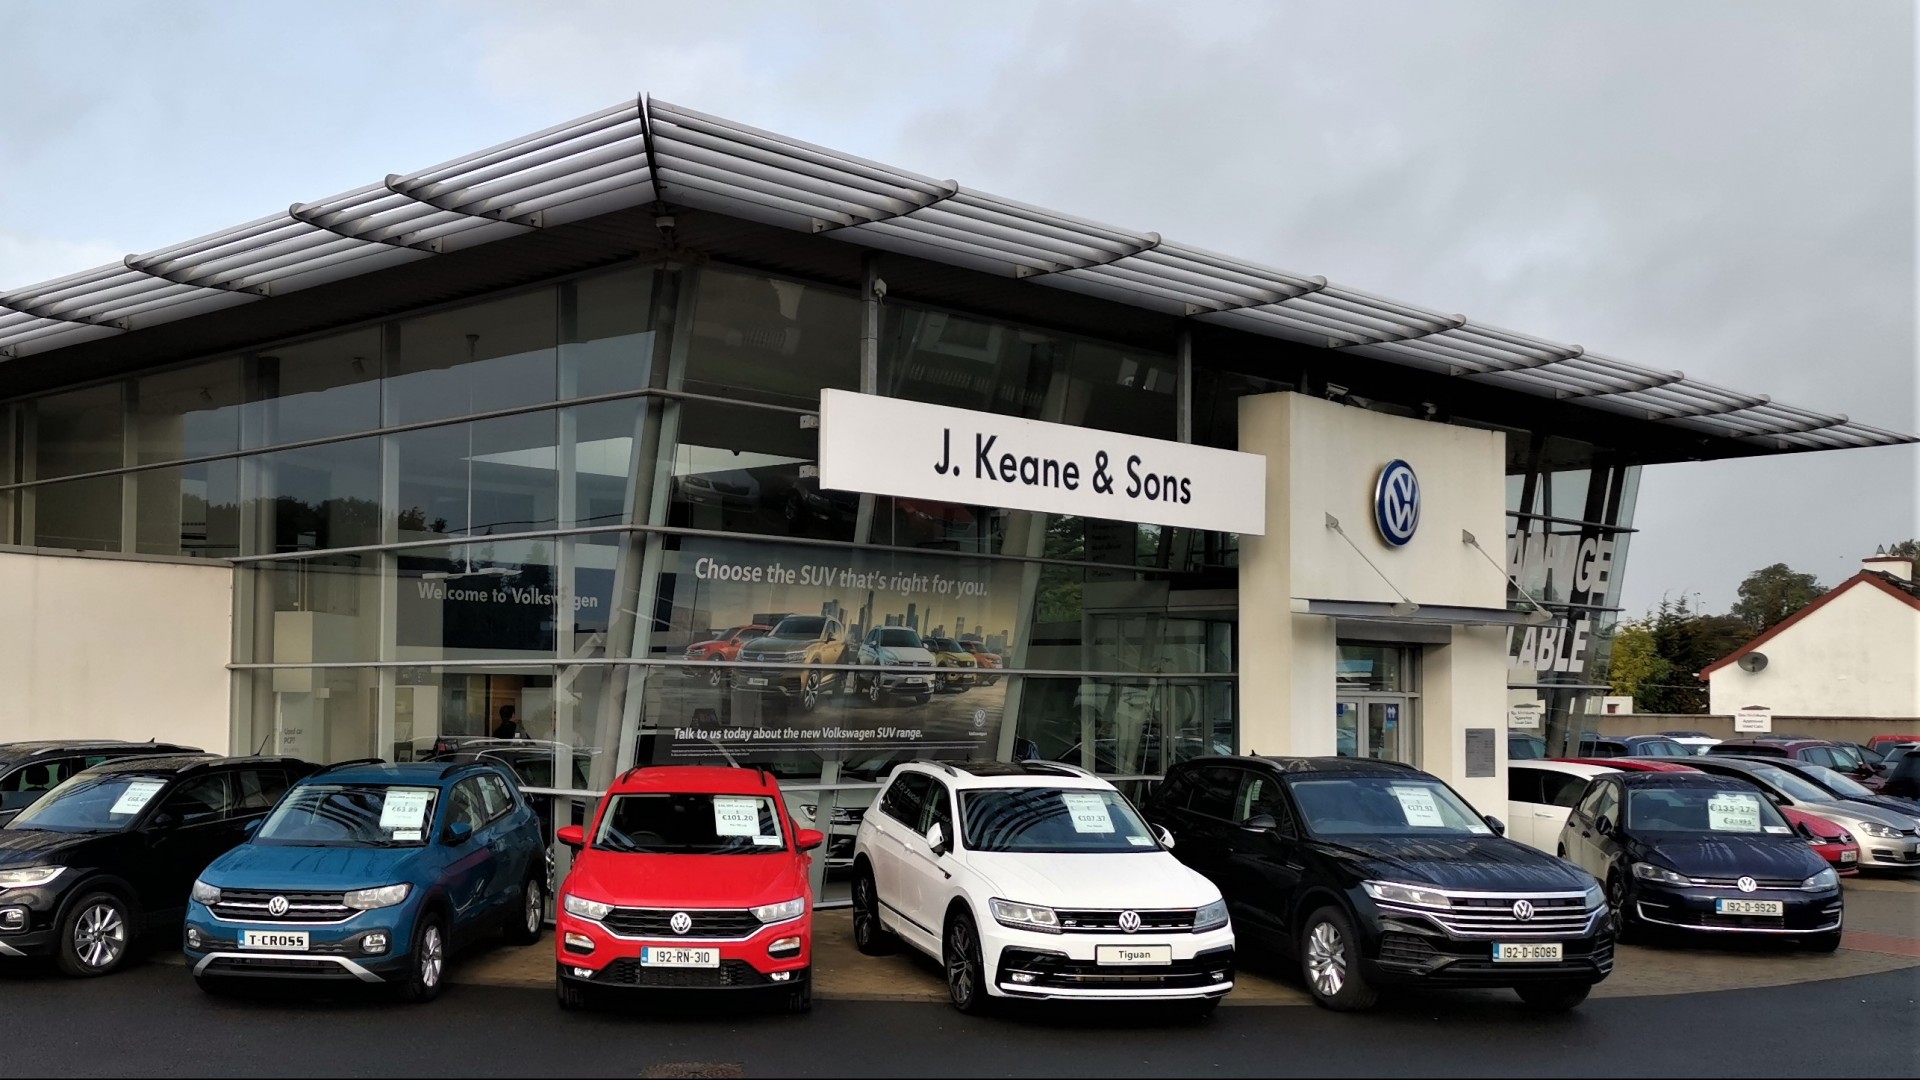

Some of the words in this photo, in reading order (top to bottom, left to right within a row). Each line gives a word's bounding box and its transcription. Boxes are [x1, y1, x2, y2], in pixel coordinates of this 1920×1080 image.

[934, 428, 960, 477] J.
[975, 433, 1079, 490] Keane
[1092, 450, 1114, 495] &
[1126, 454, 1191, 504] Sons
[695, 557, 762, 582] Choose
[766, 563, 796, 584] the
[800, 565, 837, 586] SUV
[840, 568, 886, 590] that's
[890, 572, 928, 596] right
[932, 574, 955, 594] for
[956, 581, 988, 599] you.
[418, 582, 488, 602] Welcome
[492, 588, 506, 603] to
[674, 728, 694, 740] Talk
[696, 728, 708, 740] to
[710, 730, 722, 739] us
[724, 728, 752, 742] today
[753, 728, 781, 739] about
[784, 728, 799, 738] the
[800, 730, 820, 738] new
[822, 727, 876, 741] Volkswagen
[876, 727, 896, 738] SUV
[896, 728, 922, 740] range.
[1727, 902, 1776, 912] 192-D-9929
[249, 935, 304, 946] T-CROSS
[656, 951, 710, 963] 192-RN-310
[1118, 950, 1150, 960] Tiguan
[1504, 946, 1557, 958] 192-D-16089
